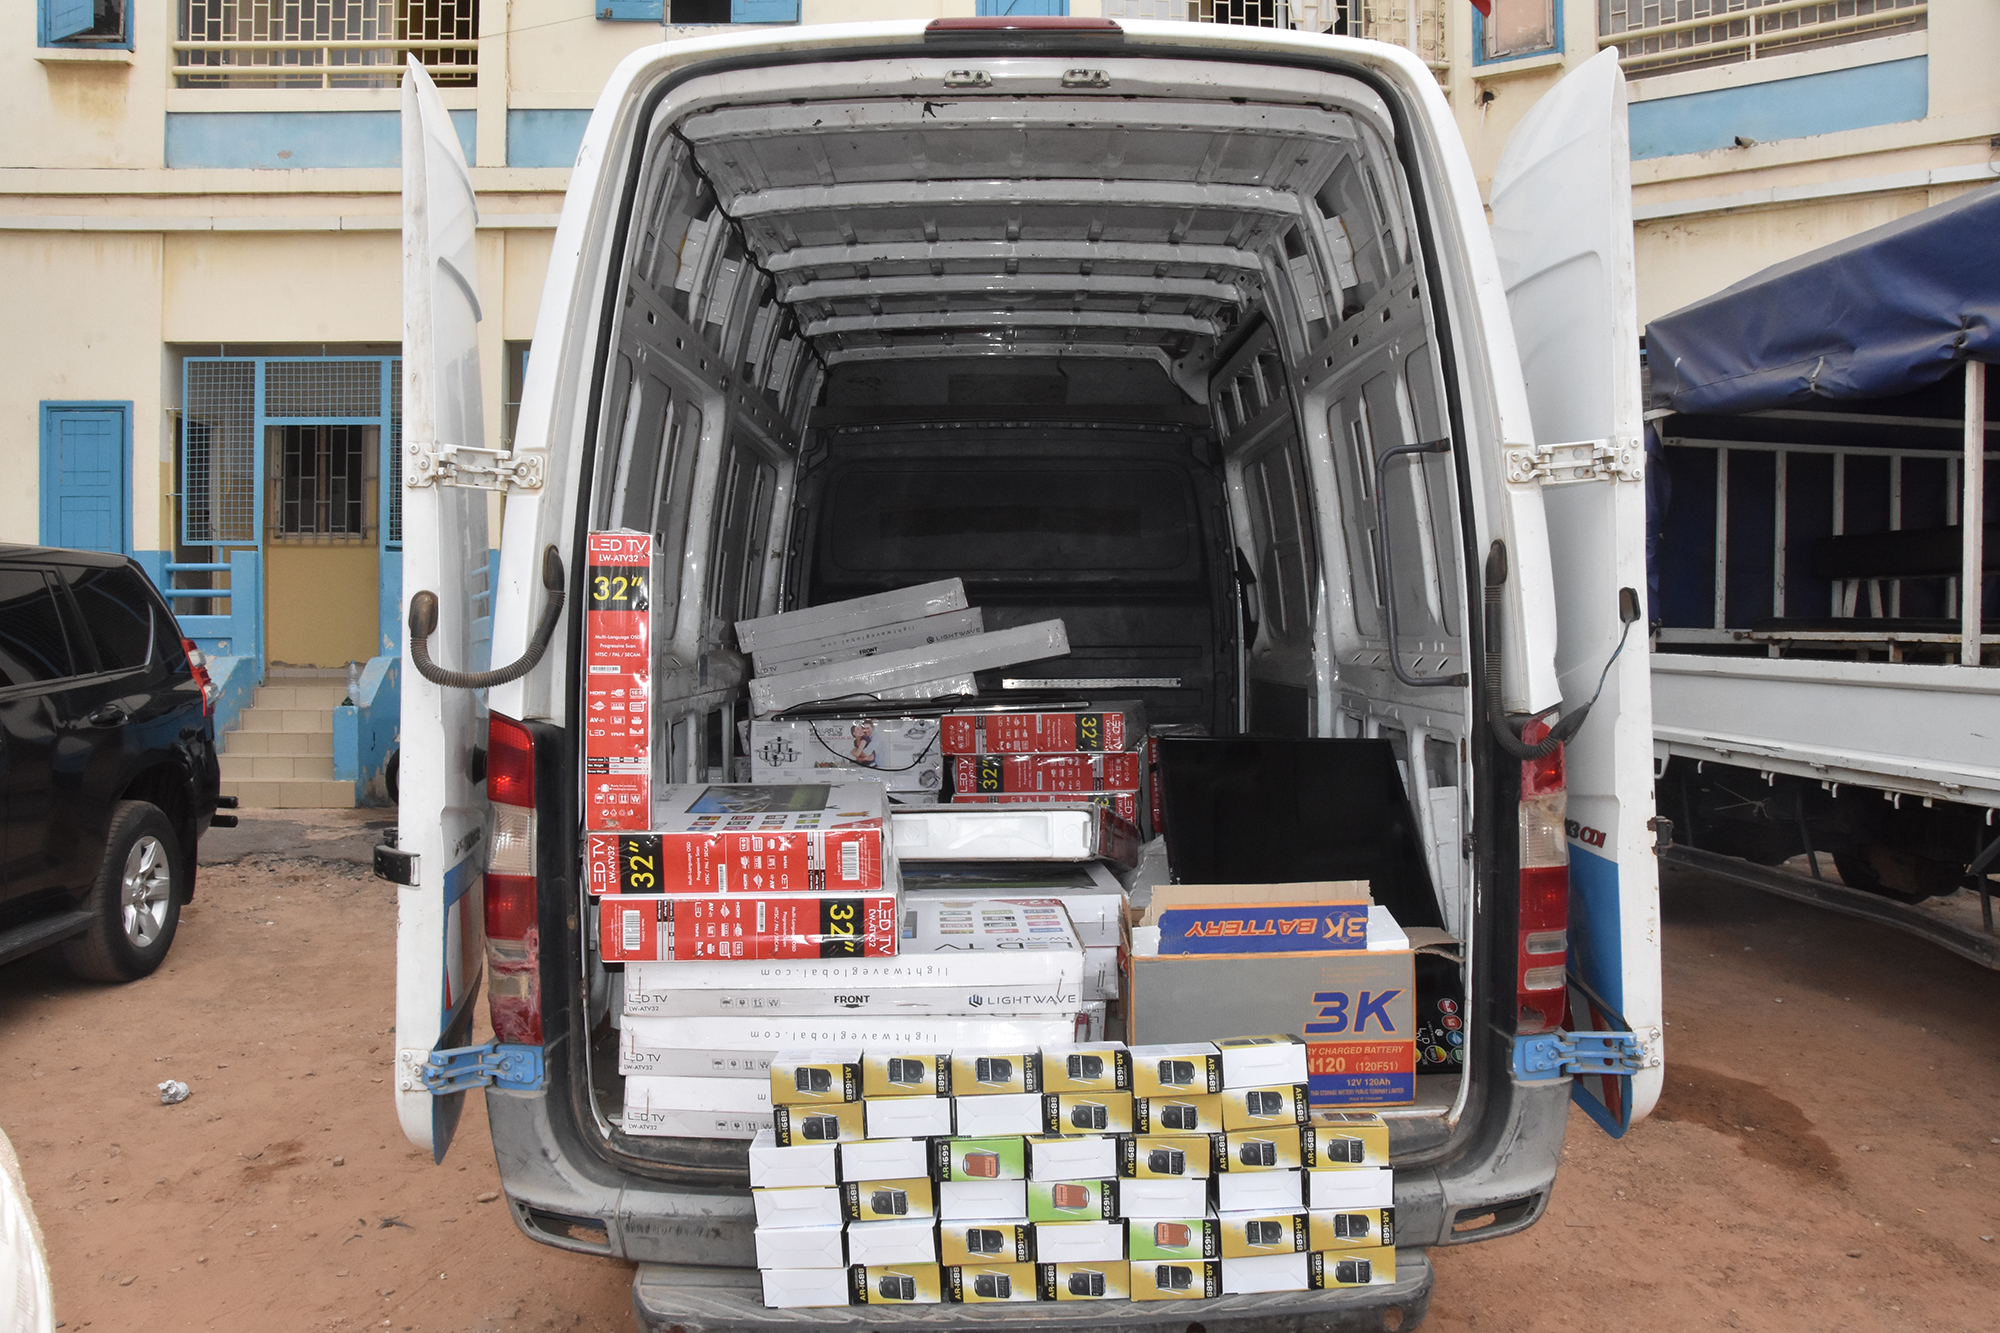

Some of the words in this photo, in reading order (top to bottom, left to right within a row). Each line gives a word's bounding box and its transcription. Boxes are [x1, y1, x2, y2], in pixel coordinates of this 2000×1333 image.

[590, 538, 623, 551] LED
[626, 539, 648, 551] TV
[599, 554, 639, 562] LW-ATV32
[593, 576, 643, 601] 32"
[936, 626, 981, 641] LIGHTWAVE
[859, 646, 878, 656] FRONT
[1111, 714, 1121, 735] LED
[589, 729, 606, 737] LED
[959, 772, 968, 792] LED
[1580, 827, 1606, 848] CDI
[592, 837, 605, 858] TV
[607, 845, 617, 884] LW-ATV32
[629, 841, 655, 888] 32"
[593, 861, 607, 892] LED
[878, 900, 892, 931] LED
[1185, 918, 1318, 938] BATTERY
[1322, 917, 1368, 939] 3K
[879, 935, 892, 954] TV
[997, 941, 1073, 950] LED
[761, 966, 949, 978] lightwaveglobal.com
[628, 994, 650, 1004] LED
[653, 994, 668, 1003] TV
[834, 995, 870, 1004] FRONT
[987, 994, 1076, 1005] LIGHTWAVE
[1303, 988, 1407, 1036] 3K
[751, 1031, 937, 1043] lightwaveglobal.com
[623, 1052, 644, 1062] LED
[647, 1053, 661, 1062] TV
[1319, 1046, 1362, 1056] CHARGED
[1364, 1046, 1404, 1054] BATTERY
[1356, 1061, 1398, 1072] (120F51)
[1347, 1079, 1362, 1087] 12V
[1365, 1078, 1391, 1086] 120Ah
[627, 1112, 649, 1122] LED
[651, 1114, 665, 1122] TV
